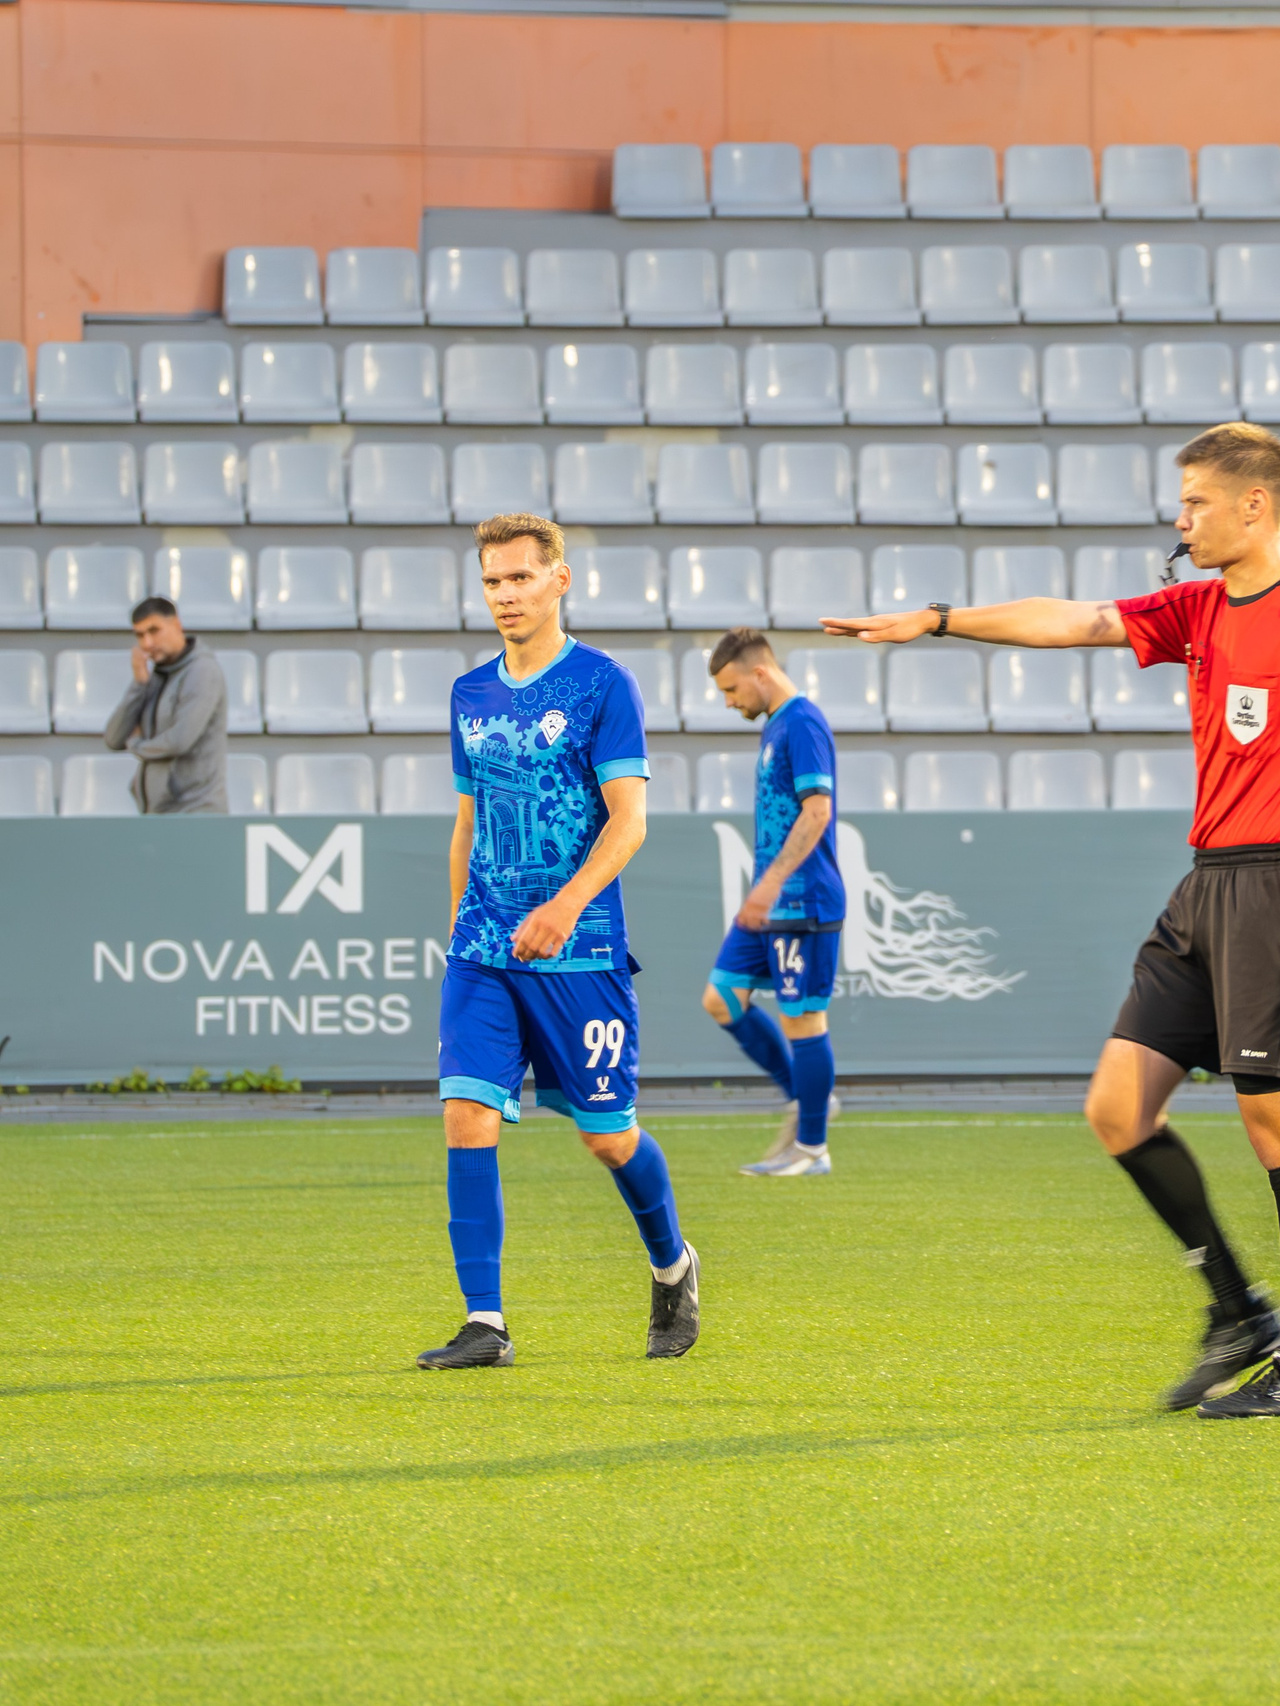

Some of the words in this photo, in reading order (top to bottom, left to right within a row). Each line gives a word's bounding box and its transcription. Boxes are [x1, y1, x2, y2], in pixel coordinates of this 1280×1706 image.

[93, 939, 275, 983] NOVA
[288, 937, 449, 980] AREN
[774, 937, 805, 974] 14
[196, 993, 412, 1036] FITNESS
[583, 1018, 625, 1069] 99
